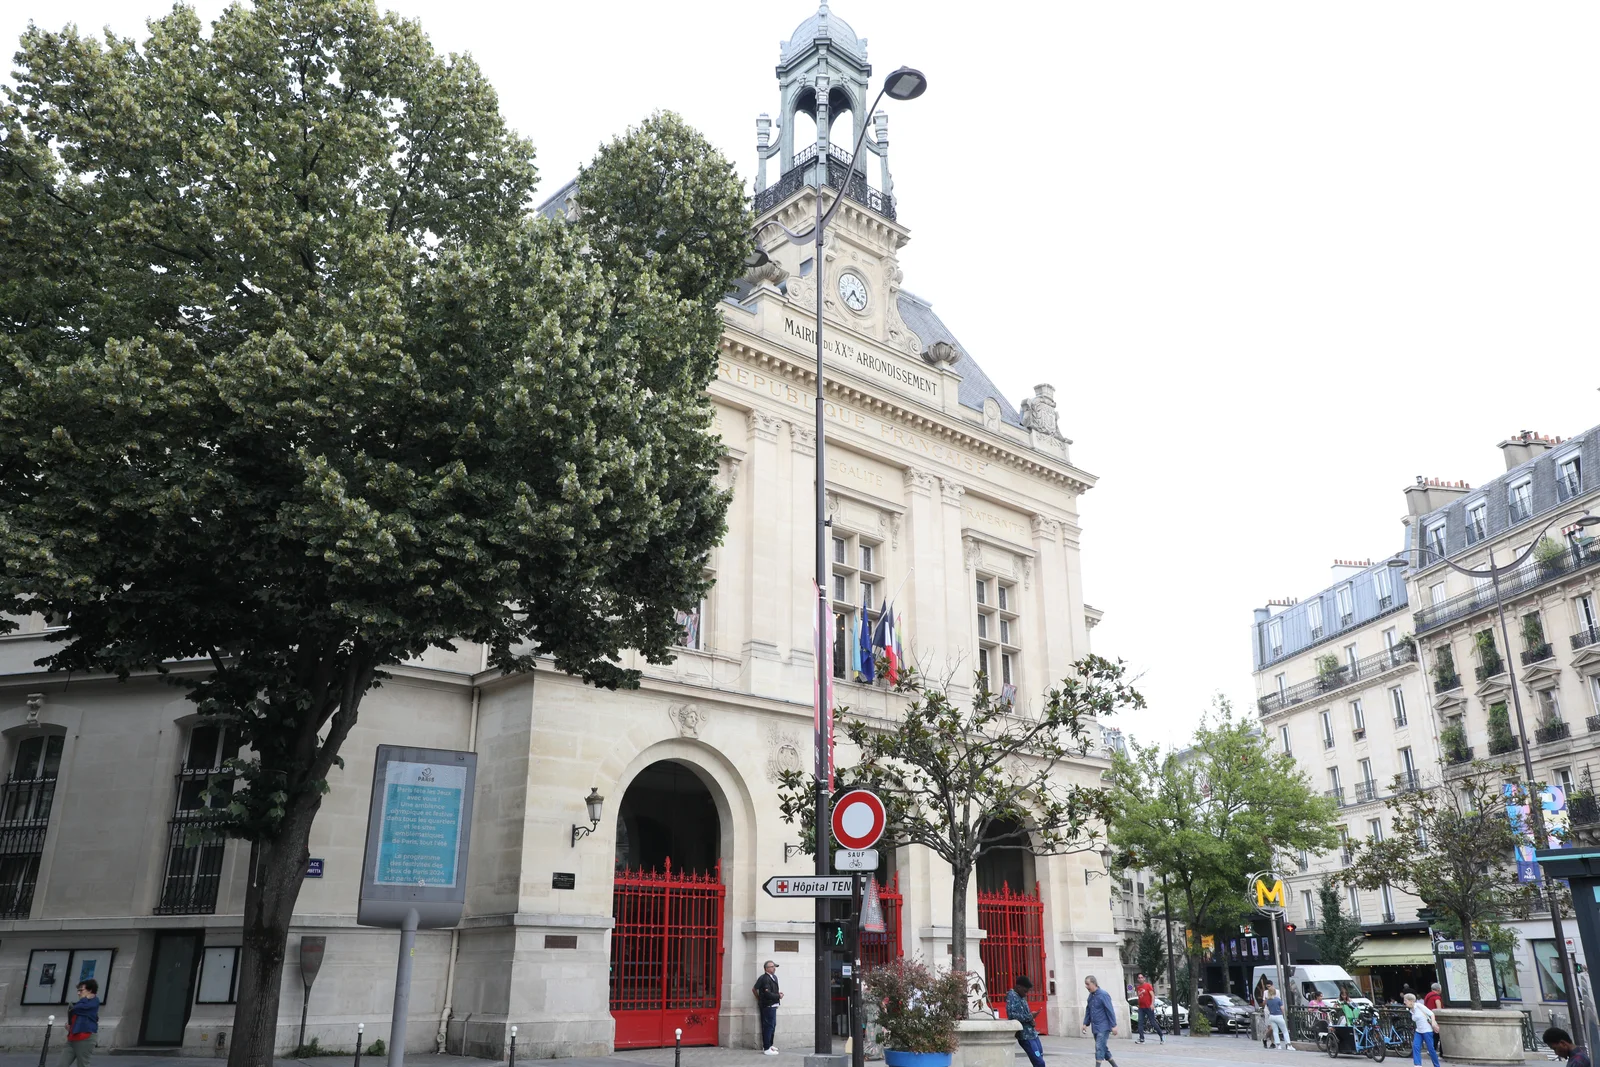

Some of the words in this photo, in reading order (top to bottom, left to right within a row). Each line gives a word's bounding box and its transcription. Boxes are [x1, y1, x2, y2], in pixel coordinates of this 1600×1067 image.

[784, 317, 818, 346] MAIRI
[856, 351, 938, 397] ARRONDISSEMENT
[717, 360, 866, 430] REPUBLQUE
[390, 808, 424, 817] olympique
[414, 802, 446, 810] ambiance
[431, 861, 444, 869] des
[792, 880, 829, 894] Hôpital
[832, 881, 862, 892] TEN
[1256, 879, 1285, 908] M
